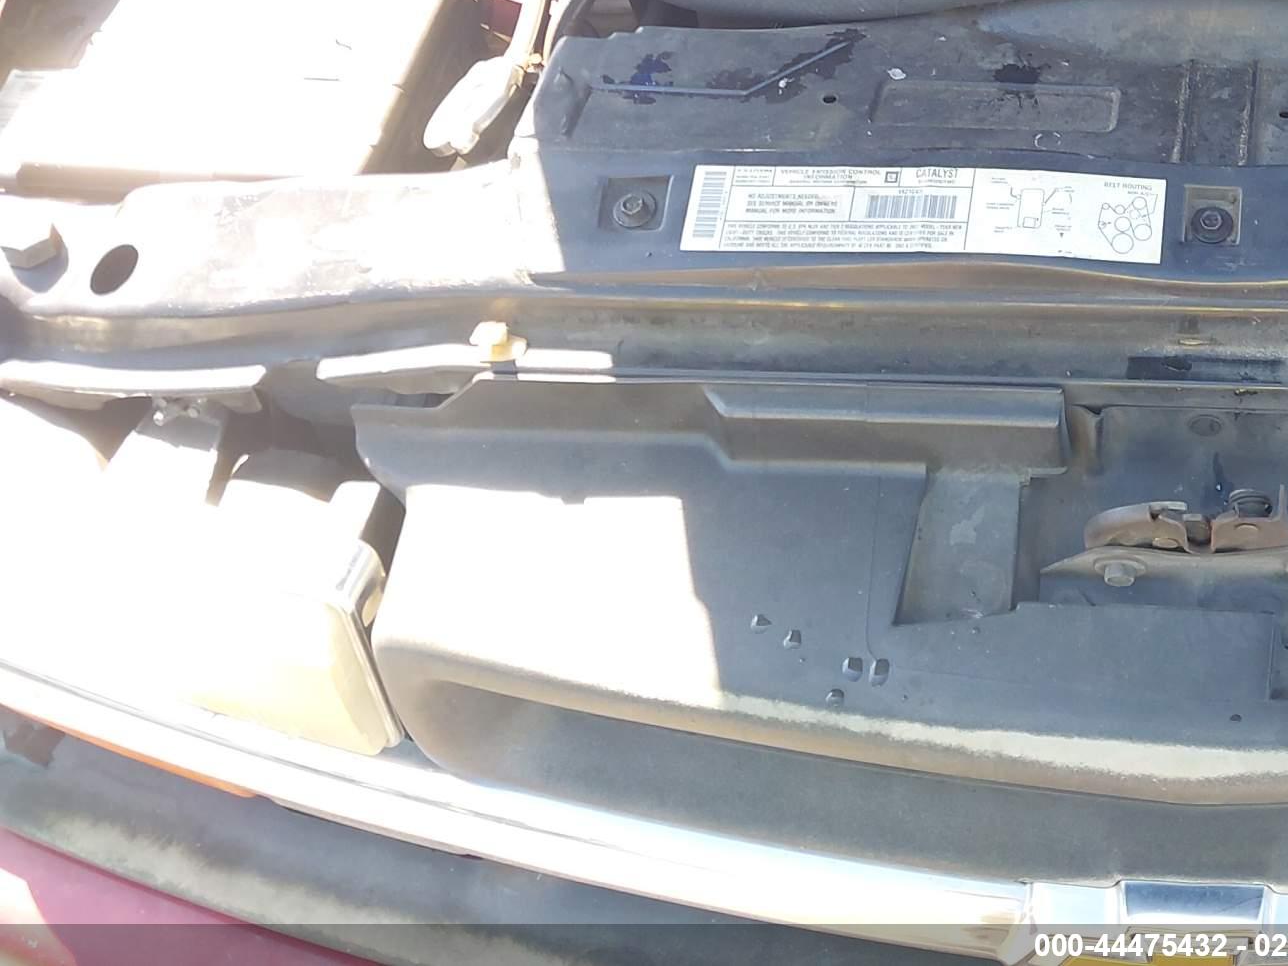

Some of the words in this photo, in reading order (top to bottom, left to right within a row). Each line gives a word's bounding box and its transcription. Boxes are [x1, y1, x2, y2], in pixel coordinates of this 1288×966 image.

[915, 169, 960, 179] CATALYST
[1104, 181, 1121, 189] BELT
[1122, 183, 1153, 192] ROUTING
